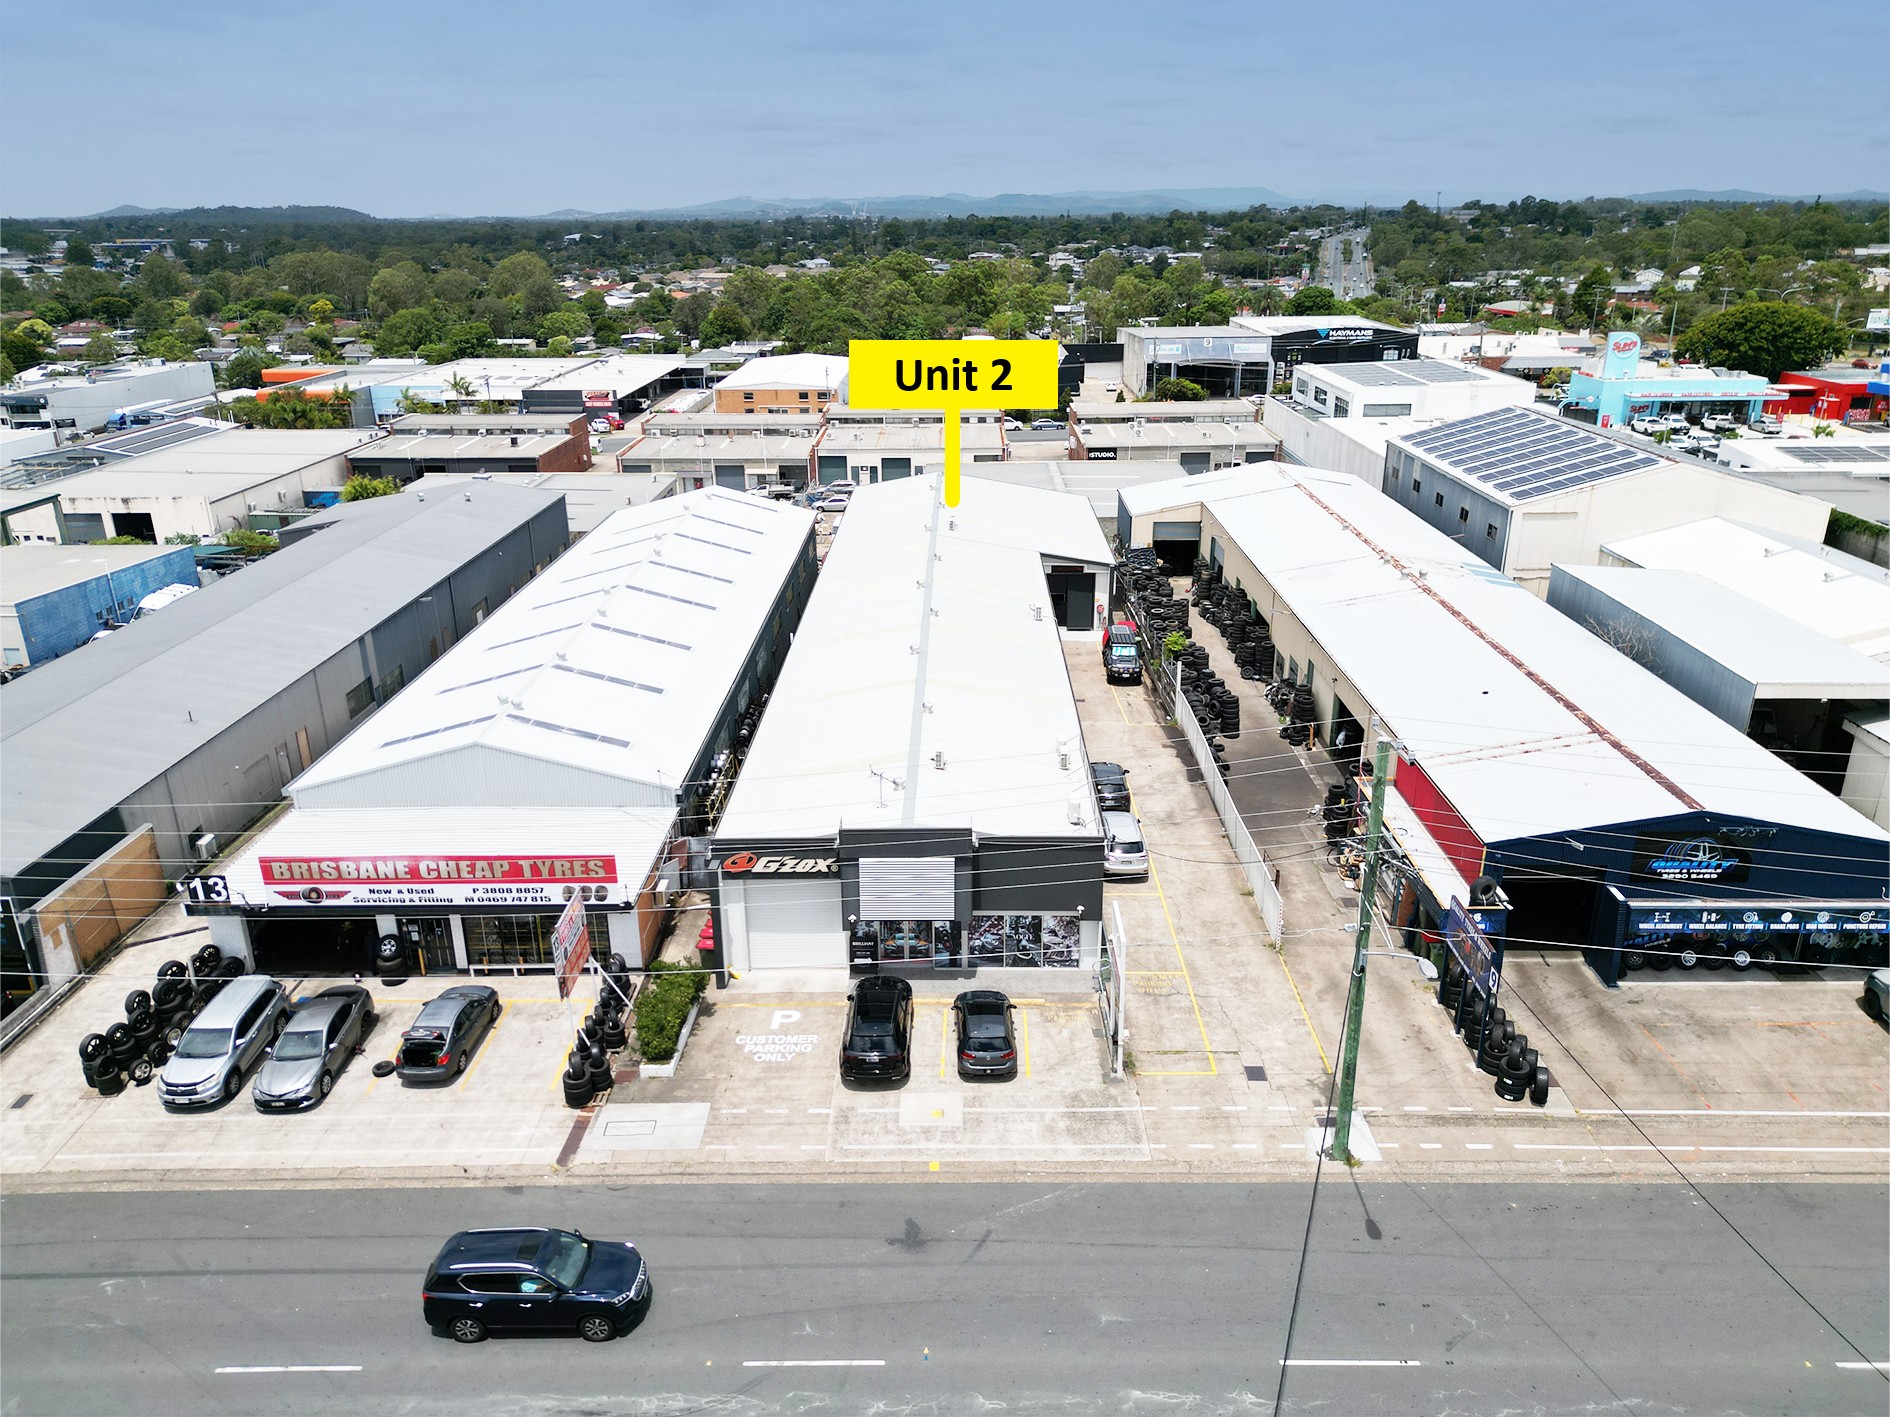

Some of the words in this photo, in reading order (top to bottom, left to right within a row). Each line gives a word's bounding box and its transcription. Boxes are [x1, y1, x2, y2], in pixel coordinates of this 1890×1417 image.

[270, 861, 411, 880] BRISBANE
[419, 860, 510, 879] CHEAP
[517, 859, 606, 878] TYRES
[189, 876, 228, 902] 13
[353, 896, 406, 904] Servicing
[418, 896, 453, 904] Fitting
[1491, 971, 1497, 989] 9
[770, 1010, 801, 1029] P
[735, 1034, 819, 1044] CUSTOMER
[743, 1043, 813, 1053] PARKING
[753, 1052, 796, 1062] ONLY
